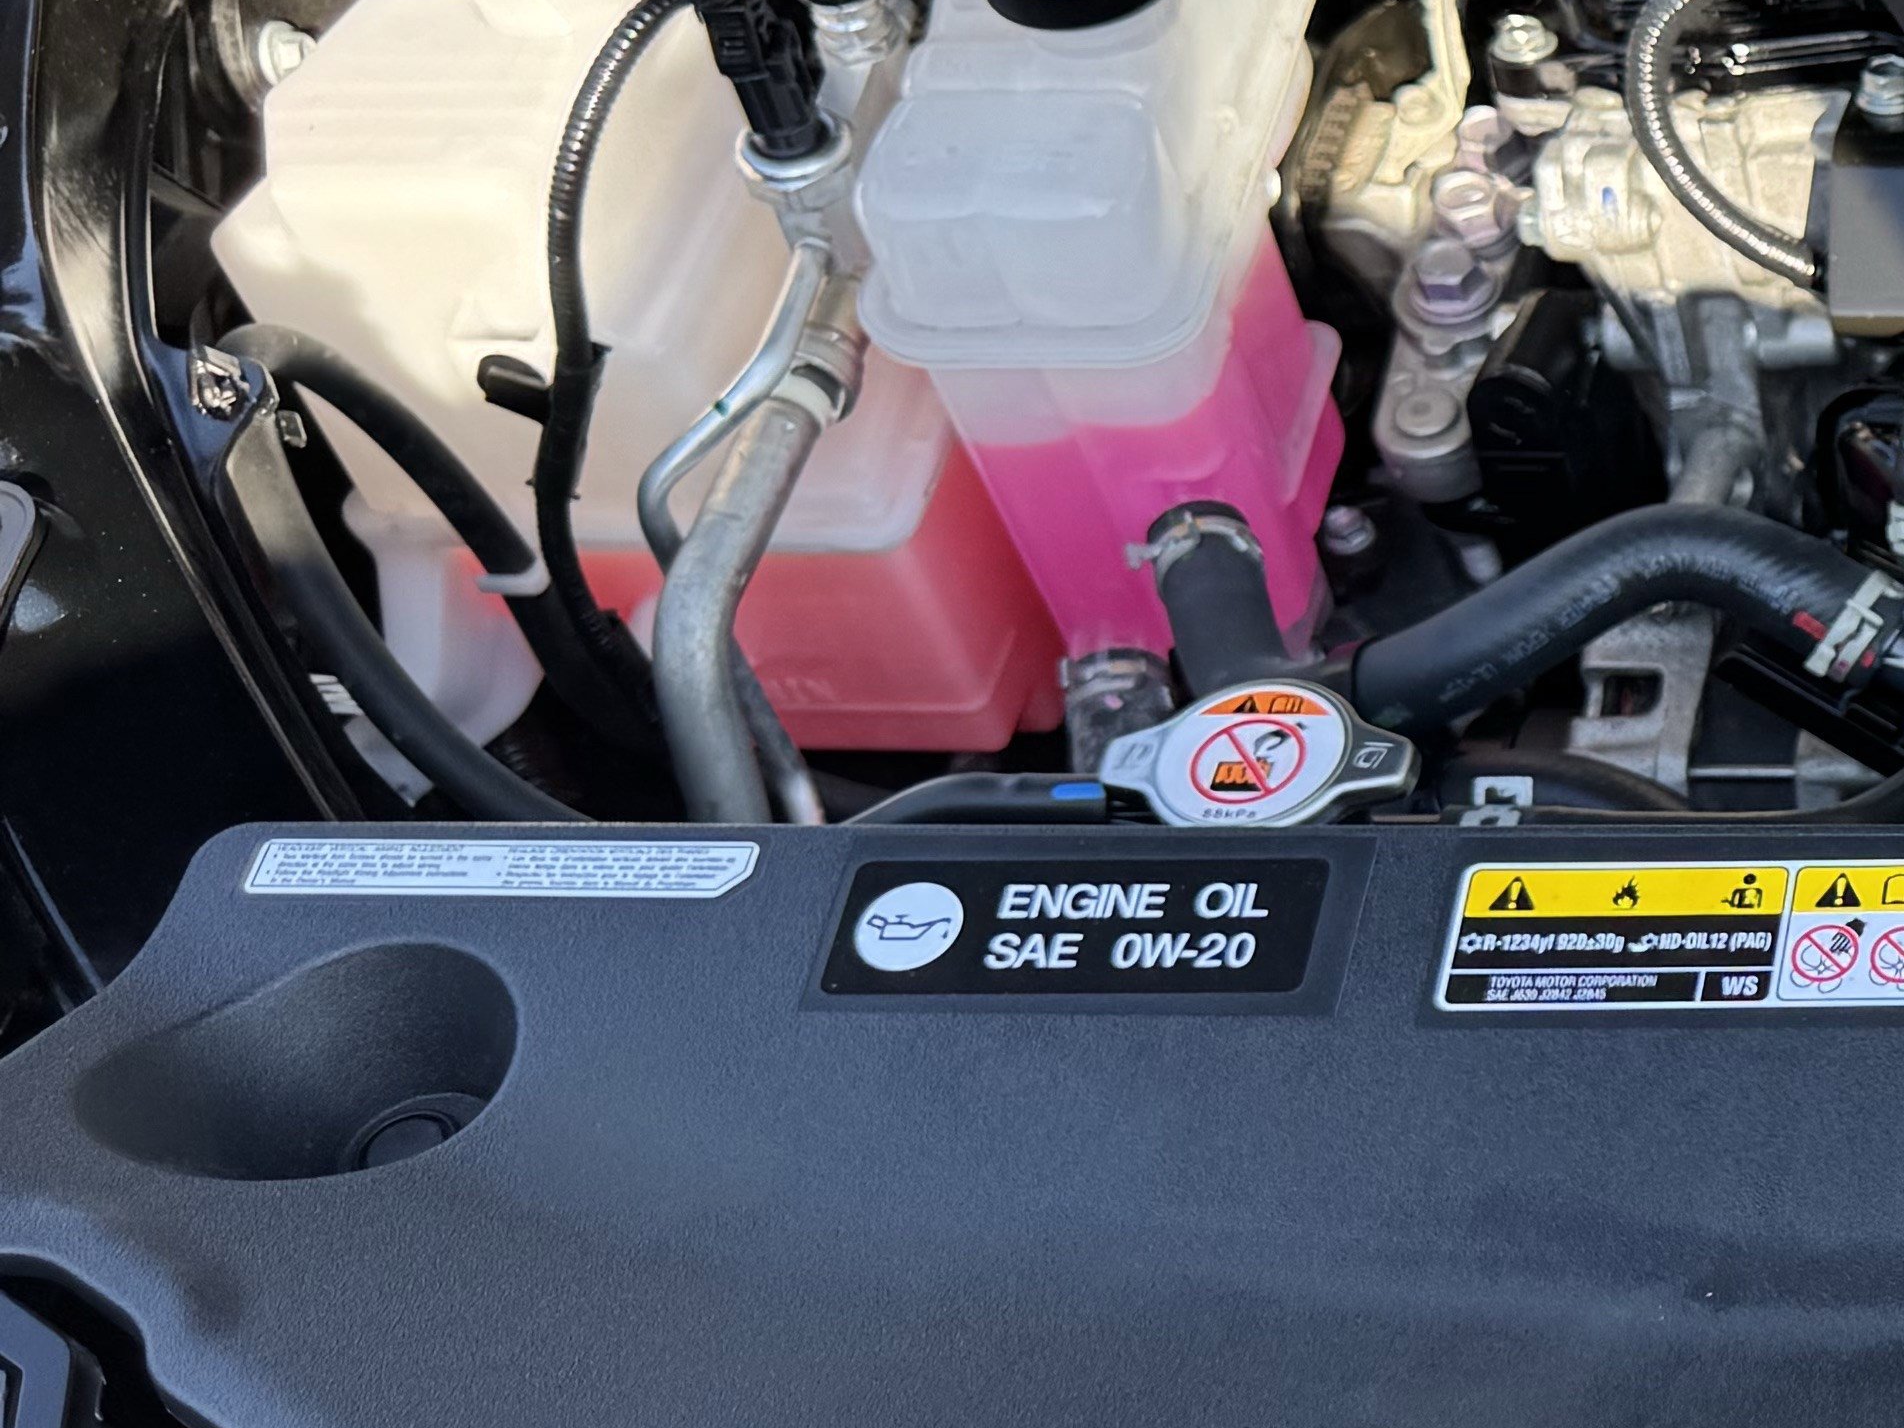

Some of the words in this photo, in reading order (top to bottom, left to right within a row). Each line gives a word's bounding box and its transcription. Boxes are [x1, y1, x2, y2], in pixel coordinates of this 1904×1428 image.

[997, 882, 1171, 919] ENGINE
[1193, 882, 1270, 919] OIL
[983, 931, 1085, 970] SAE
[1110, 931, 1257, 970] 0W-20
[1489, 975, 1534, 988] TOYOTA
[1535, 975, 1576, 988] MOTOR
[1577, 974, 1658, 988] CORPORATION
[1721, 975, 1760, 997] WS
[1486, 988, 1510, 1001] SAE
